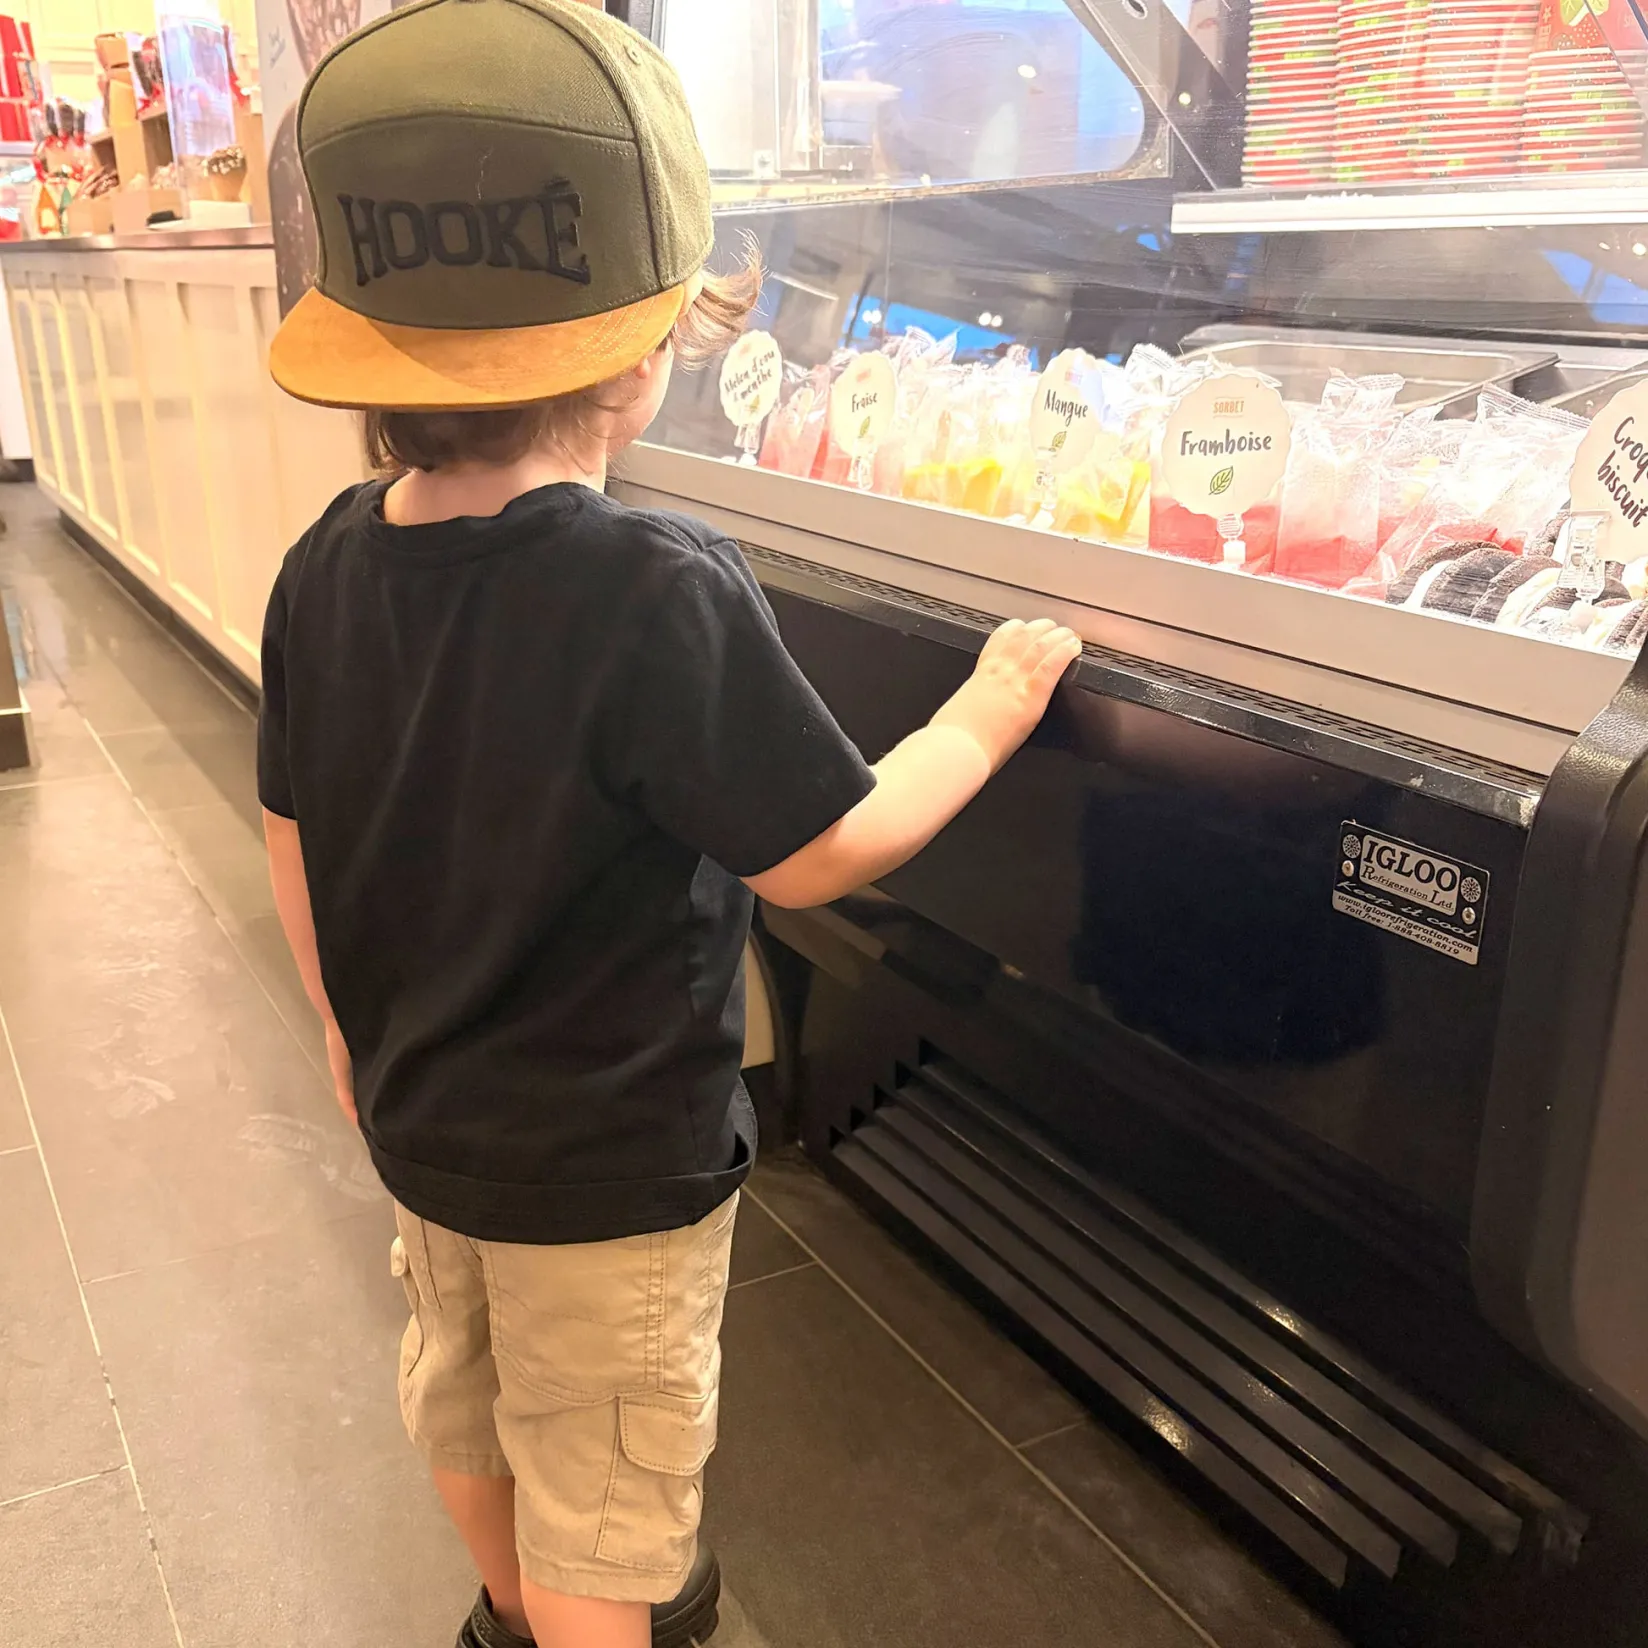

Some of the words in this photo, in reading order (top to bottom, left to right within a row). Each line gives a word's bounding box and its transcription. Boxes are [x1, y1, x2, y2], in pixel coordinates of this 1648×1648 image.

[851, 392, 878, 413] Fraise
[1044, 388, 1089, 427] Mangue
[1213, 401, 1245, 414] SORBET
[1180, 428, 1272, 456] Framboise
[1614, 416, 1648, 483] Croq
[1597, 449, 1648, 528] biscuit
[1361, 864, 1428, 900] Refrigeration
[1363, 840, 1458, 892] IGLOO
[1336, 881, 1394, 907] Keep
[1400, 906, 1423, 917] it
[1426, 917, 1477, 939] cool
[1338, 895, 1473, 953] www.igloorefrigeration.com
[1345, 904, 1363, 917] Toll
[1362, 912, 1384, 925] free:
